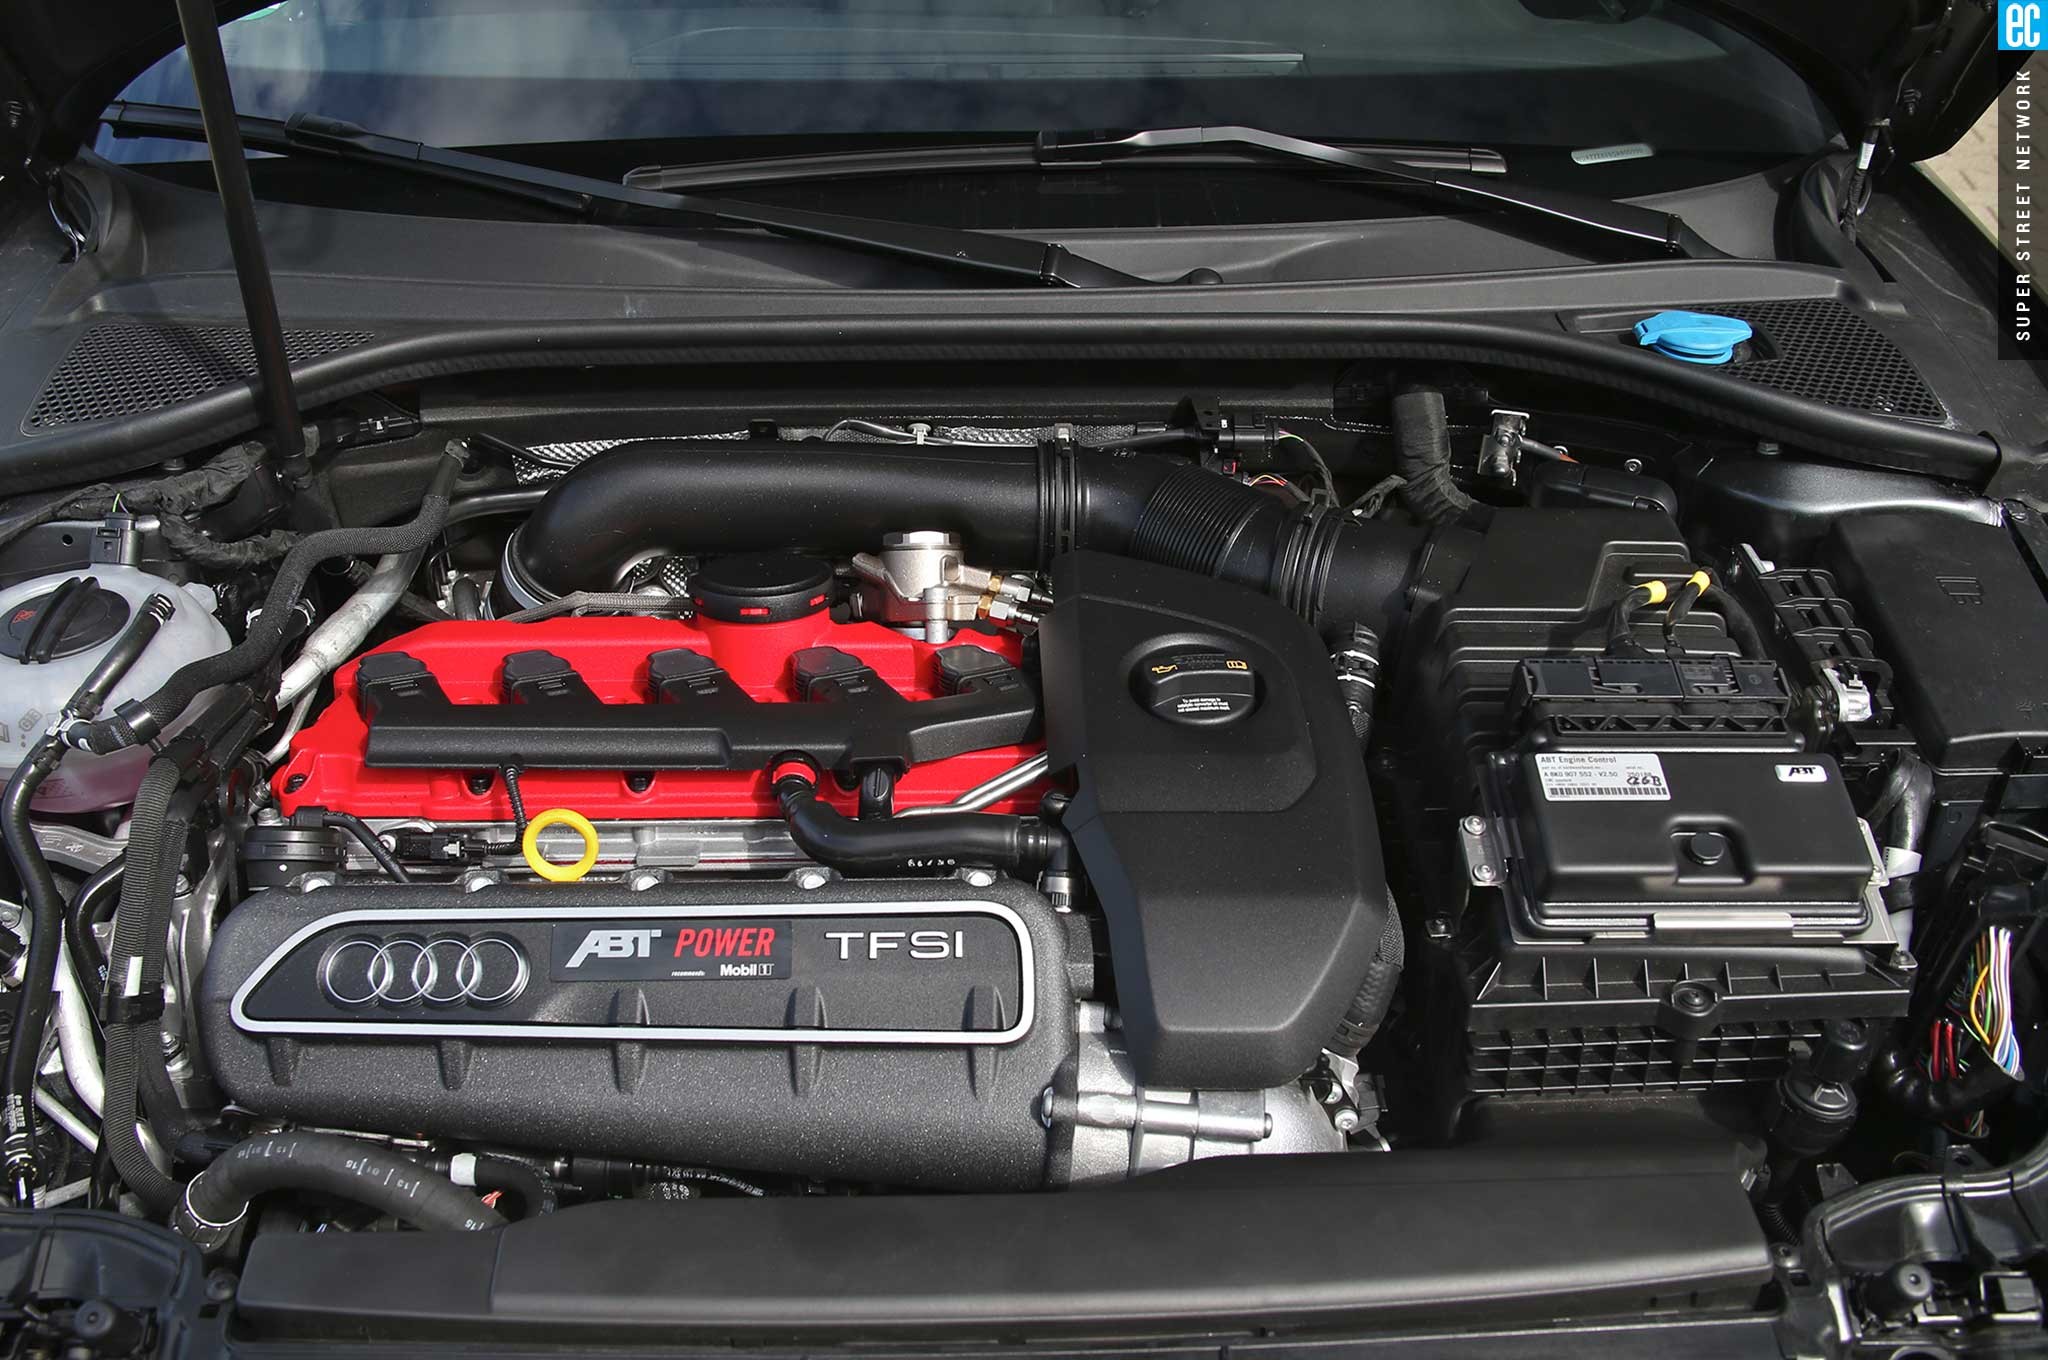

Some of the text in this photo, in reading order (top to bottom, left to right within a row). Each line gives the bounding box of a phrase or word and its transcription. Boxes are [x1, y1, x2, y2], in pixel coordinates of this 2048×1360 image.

[1558, 756, 1586, 765] Engine
[1788, 767, 1816, 777] ABT
[565, 927, 776, 968] ABT POWER
[825, 930, 963, 960] TFSI
[720, 963, 757, 977] Mobil
